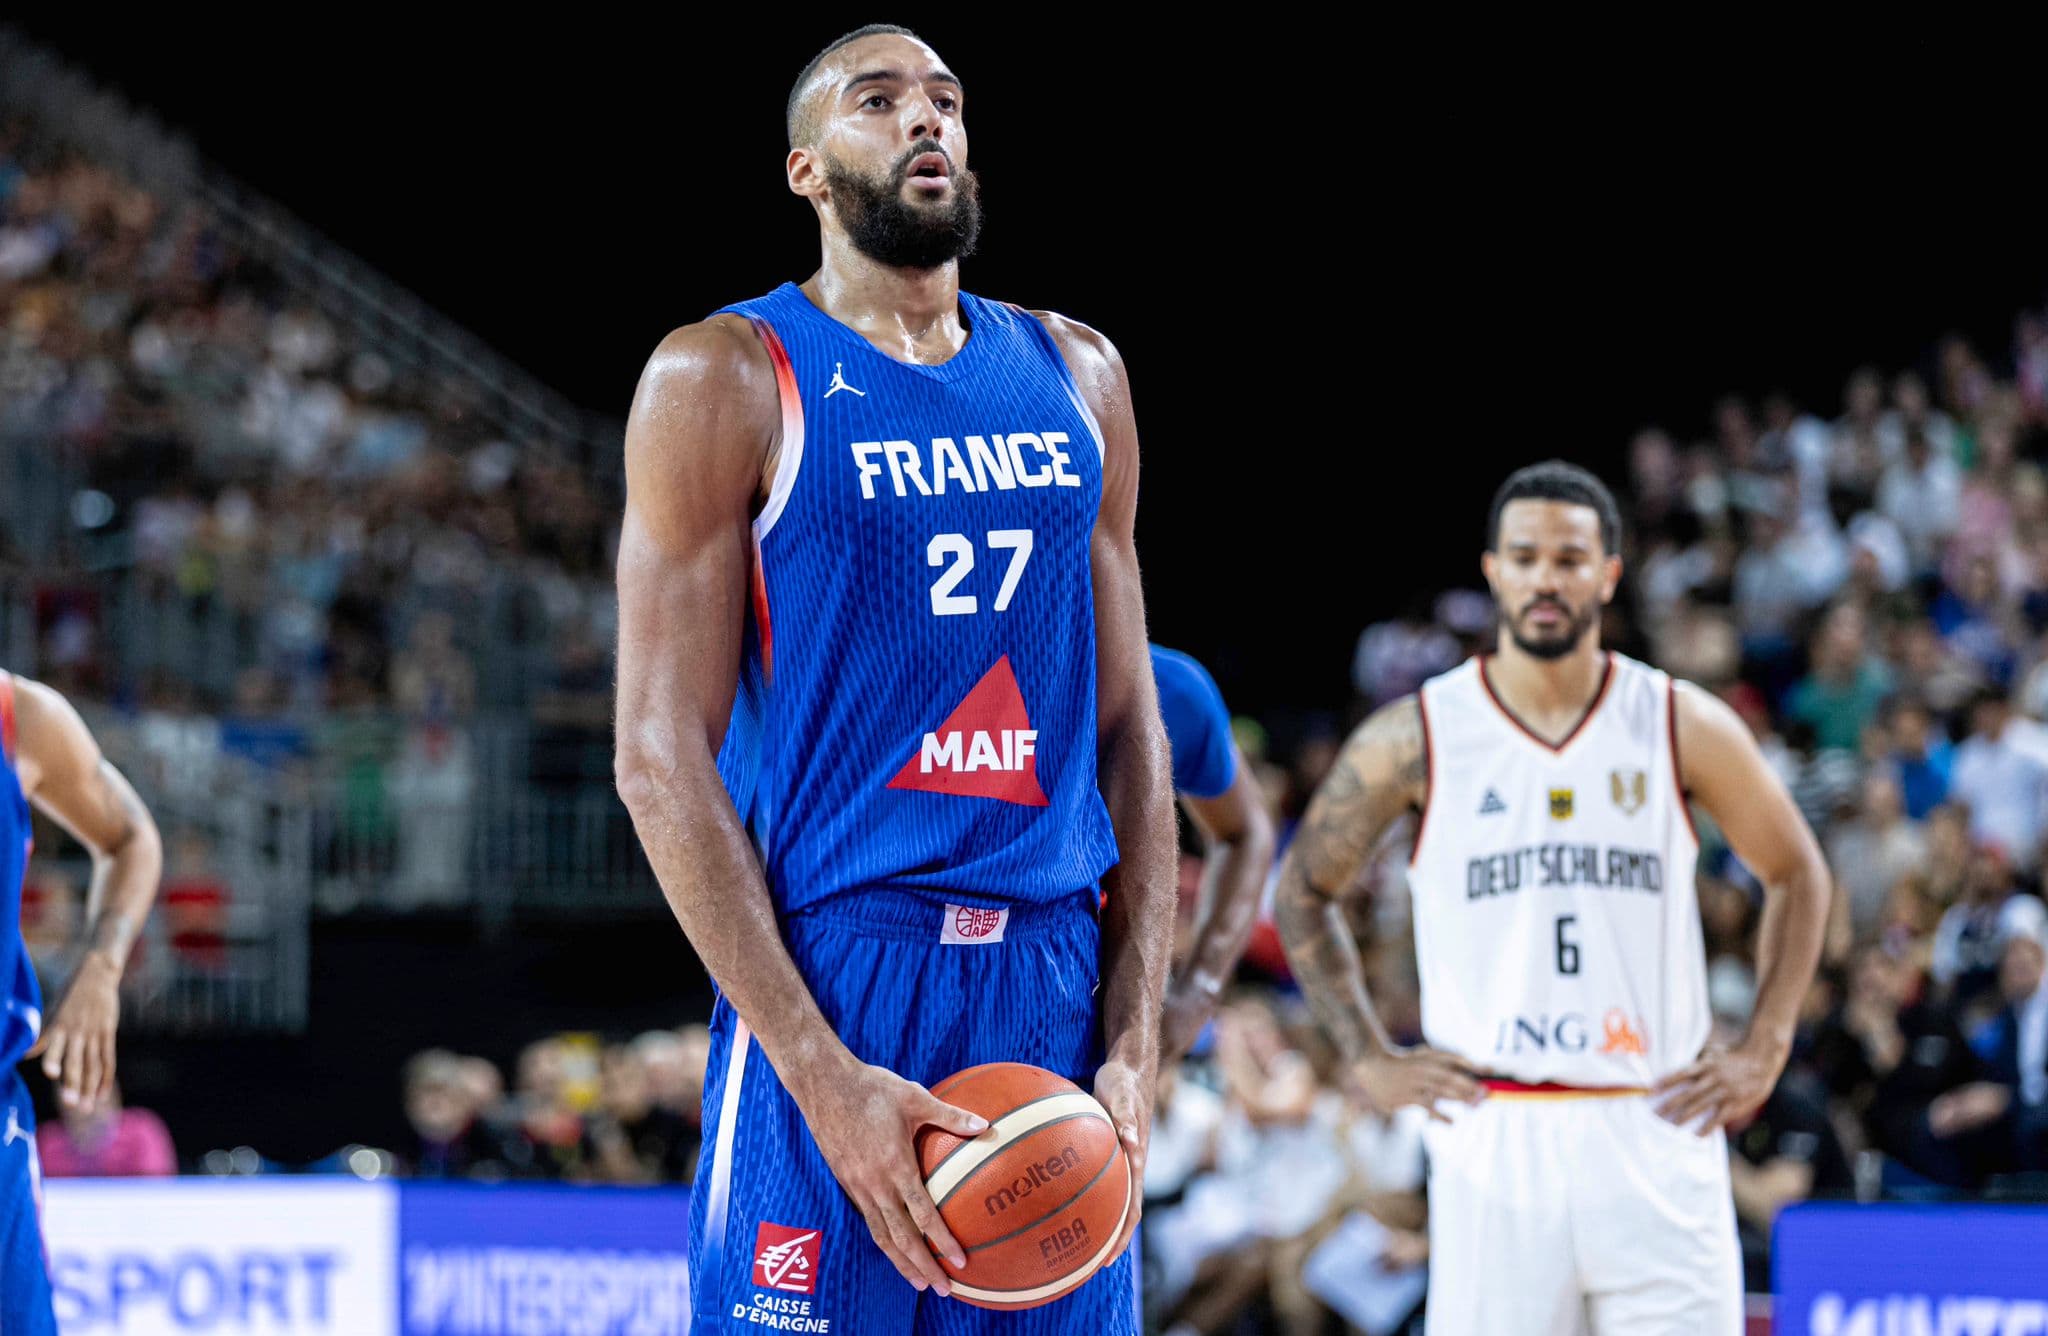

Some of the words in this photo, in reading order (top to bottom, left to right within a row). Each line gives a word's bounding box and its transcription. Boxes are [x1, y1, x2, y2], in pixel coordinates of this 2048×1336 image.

[851, 432, 1081, 499] FRANCE
[927, 529, 1033, 616] 27
[920, 730, 1038, 774] MAIF
[1467, 843, 1663, 899] DEUTSCHLAND
[1556, 915, 1579, 976] 6
[1495, 1012, 1589, 1054] ING
[984, 1146, 1081, 1217] molten
[1039, 1217, 1088, 1259] FIBA
[1046, 1236, 1092, 1268] APPROVED
[732, 1303, 830, 1334] D'EPARGNE
[753, 1293, 811, 1316] CAISSE
